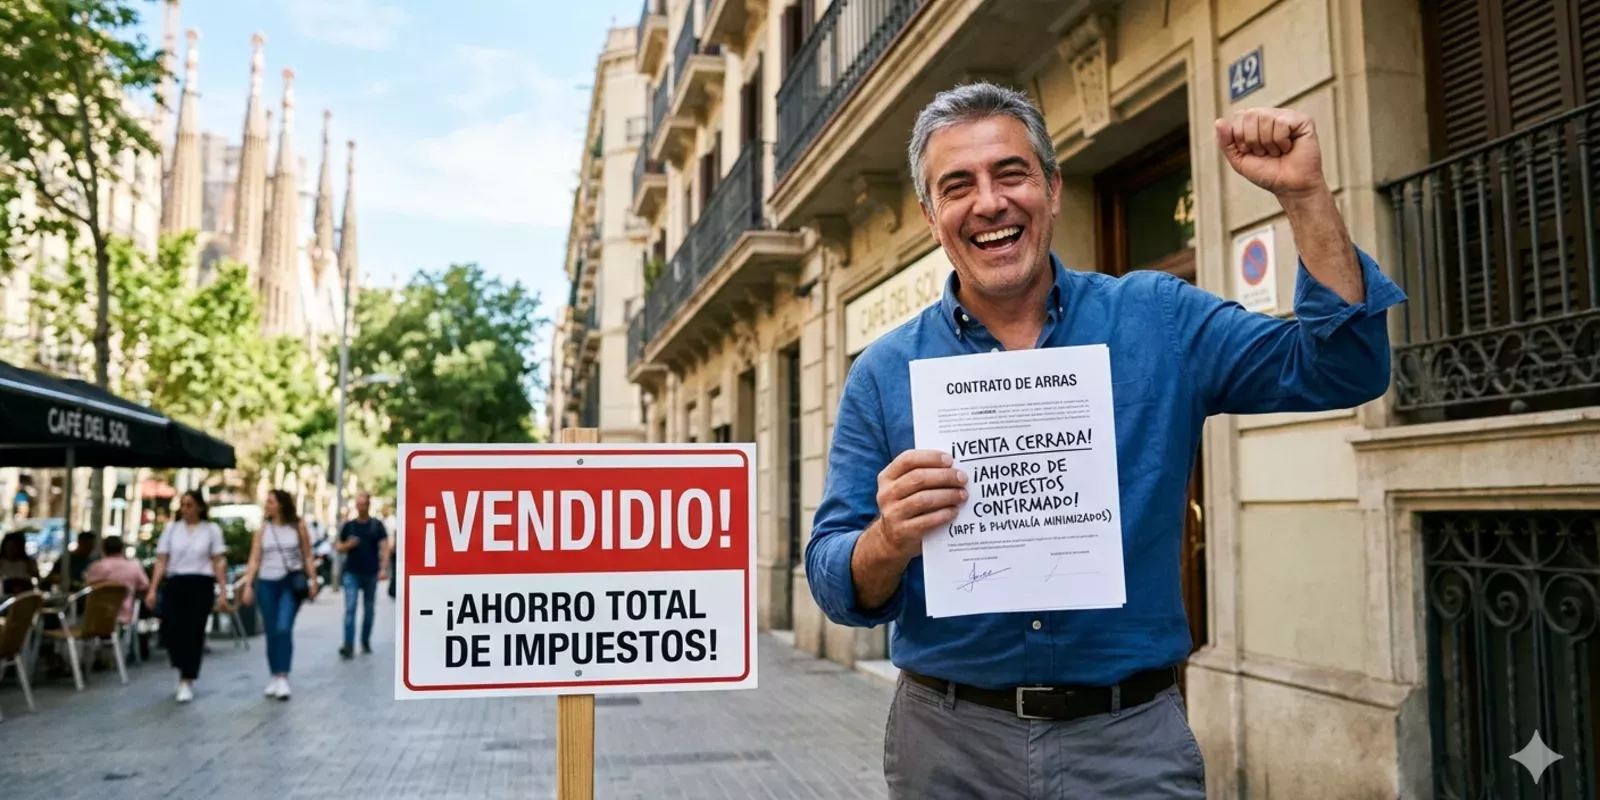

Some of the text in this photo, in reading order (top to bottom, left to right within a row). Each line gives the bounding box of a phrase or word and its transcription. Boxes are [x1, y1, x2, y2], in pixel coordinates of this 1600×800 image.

[1231, 55, 1259, 94] 42
[890, 284, 912, 319] DEL
[946, 373, 1077, 395] CONTRATO DE ARRAS
[47, 407, 131, 447] CAFÉ DEL SOL
[952, 428, 1092, 459] ¡VENTA CERRADA!
[973, 458, 1068, 483] ¡AHORRO DE
[981, 475, 1065, 499] IMPUESTOS
[973, 492, 1079, 518] CONFIRMADO!
[1043, 508, 1112, 527] MINIMIZADOS)
[424, 488, 732, 568] ¡VENDIDIO!
[446, 591, 596, 631] ¡AHORRO
[605, 589, 706, 621] TOTAL
[445, 629, 718, 668] DE IMPUESTOS!
